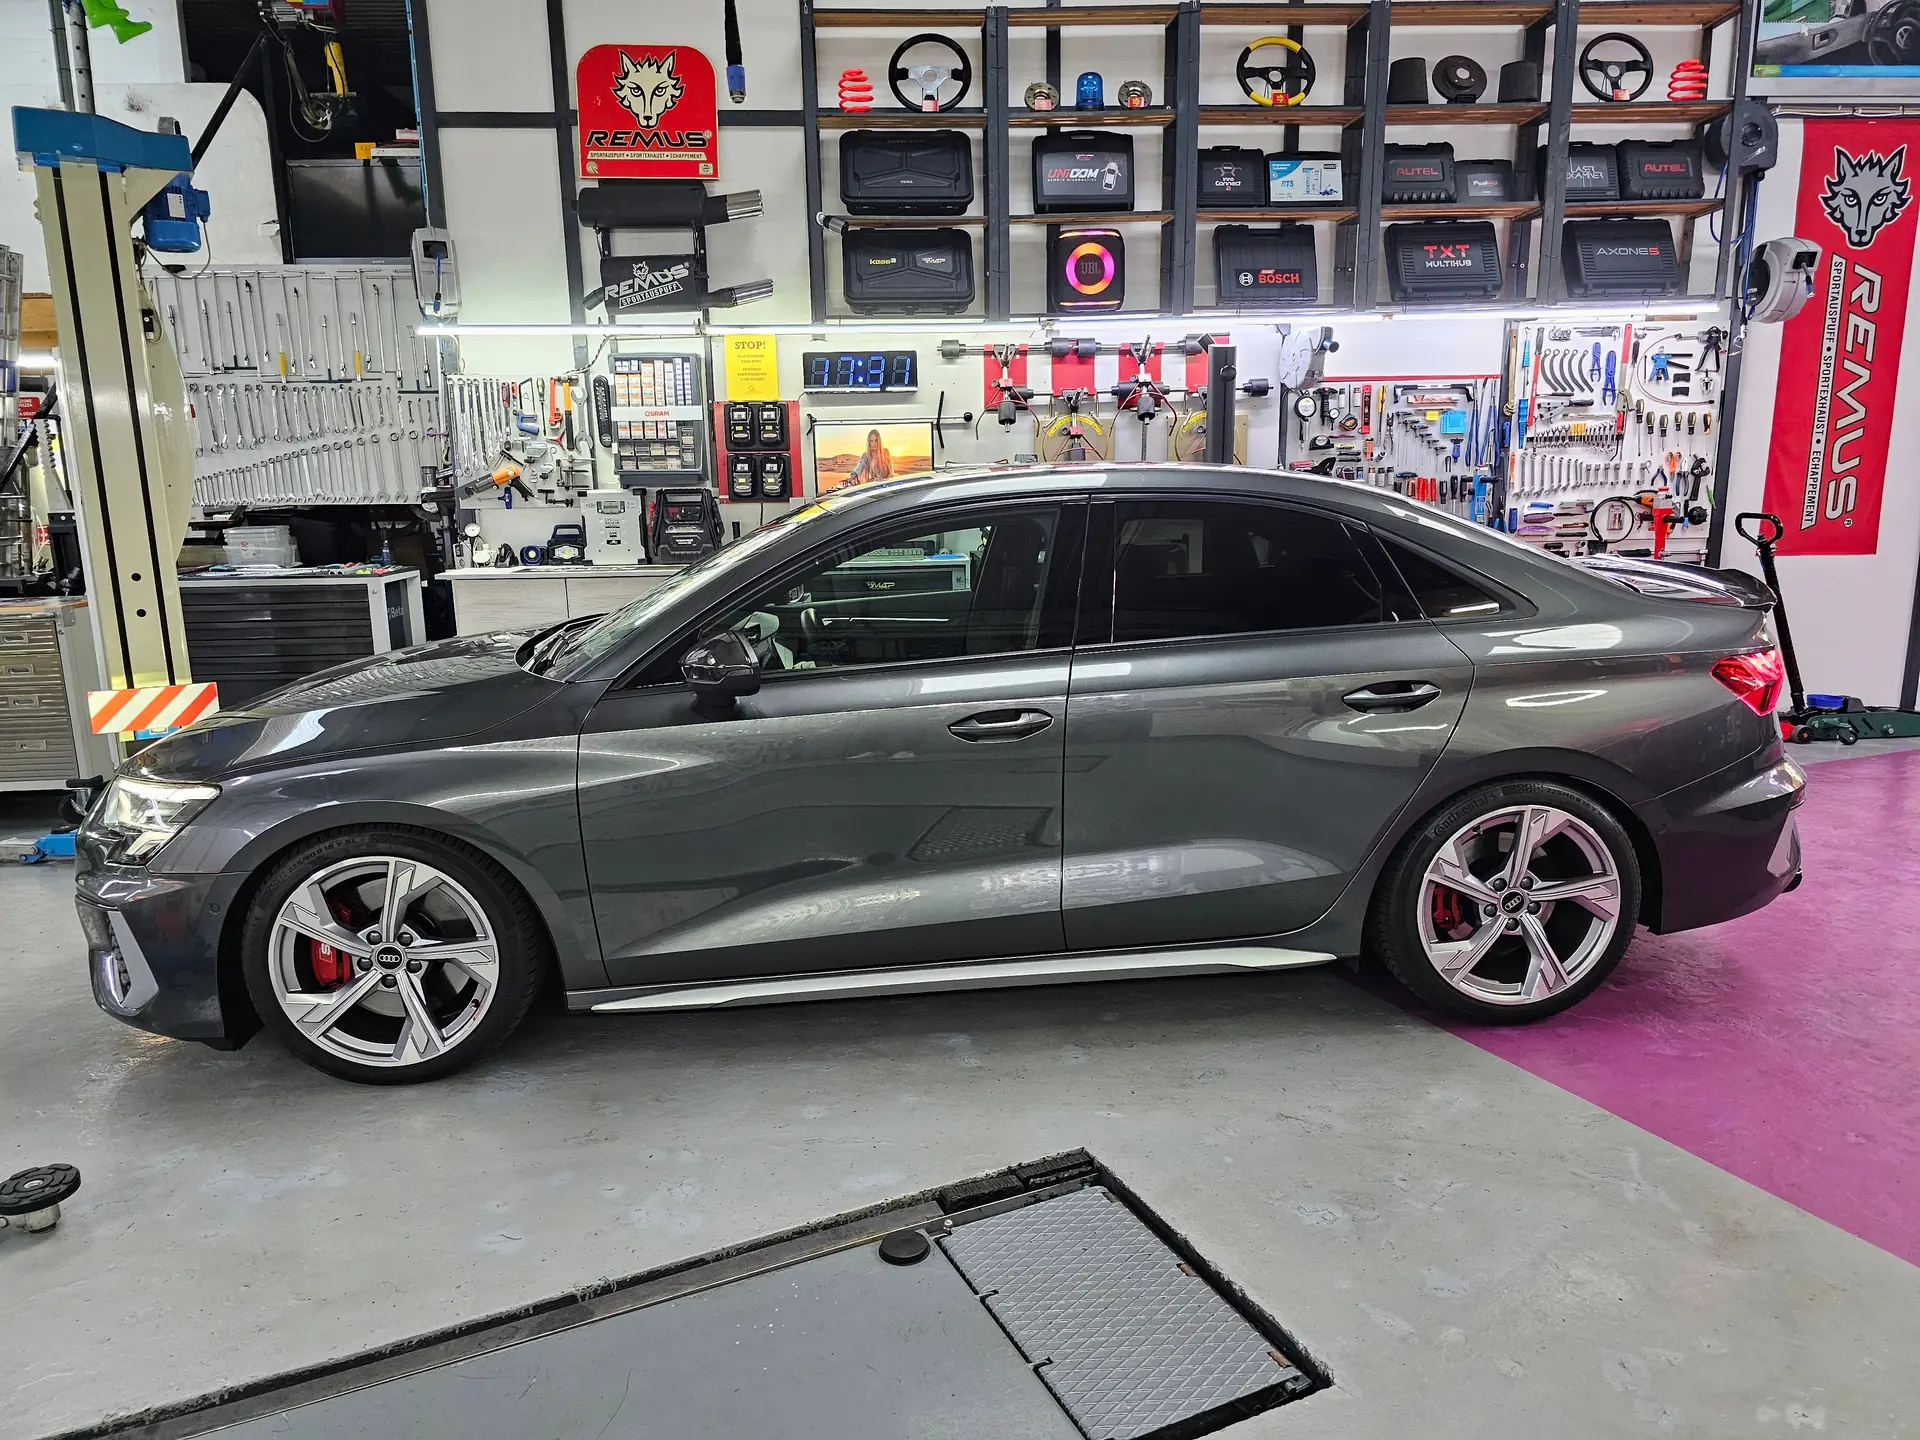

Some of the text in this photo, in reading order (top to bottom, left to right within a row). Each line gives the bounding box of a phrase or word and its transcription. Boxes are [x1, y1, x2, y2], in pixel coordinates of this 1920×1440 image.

[1396, 166, 1439, 176] AUTEL
[1570, 165, 1596, 173] LASER
[1643, 163, 1687, 173] AUTEL
[1423, 244, 1471, 259] TXT
[1080, 261, 1101, 275] JBL
[1425, 259, 1473, 269] MULTIHUB
[604, 264, 689, 301] REMUS
[1258, 273, 1300, 284] BOSCH
[621, 283, 678, 306] SPORTAUSPUFF
[734, 341, 766, 350] STOP!
[1804, 261, 1843, 523] SPORTAUSPUFF SPORTEXHAUST ECHAPPEMENT
[1824, 262, 1883, 520] REMUS
[644, 410, 670, 418] OSRAM
